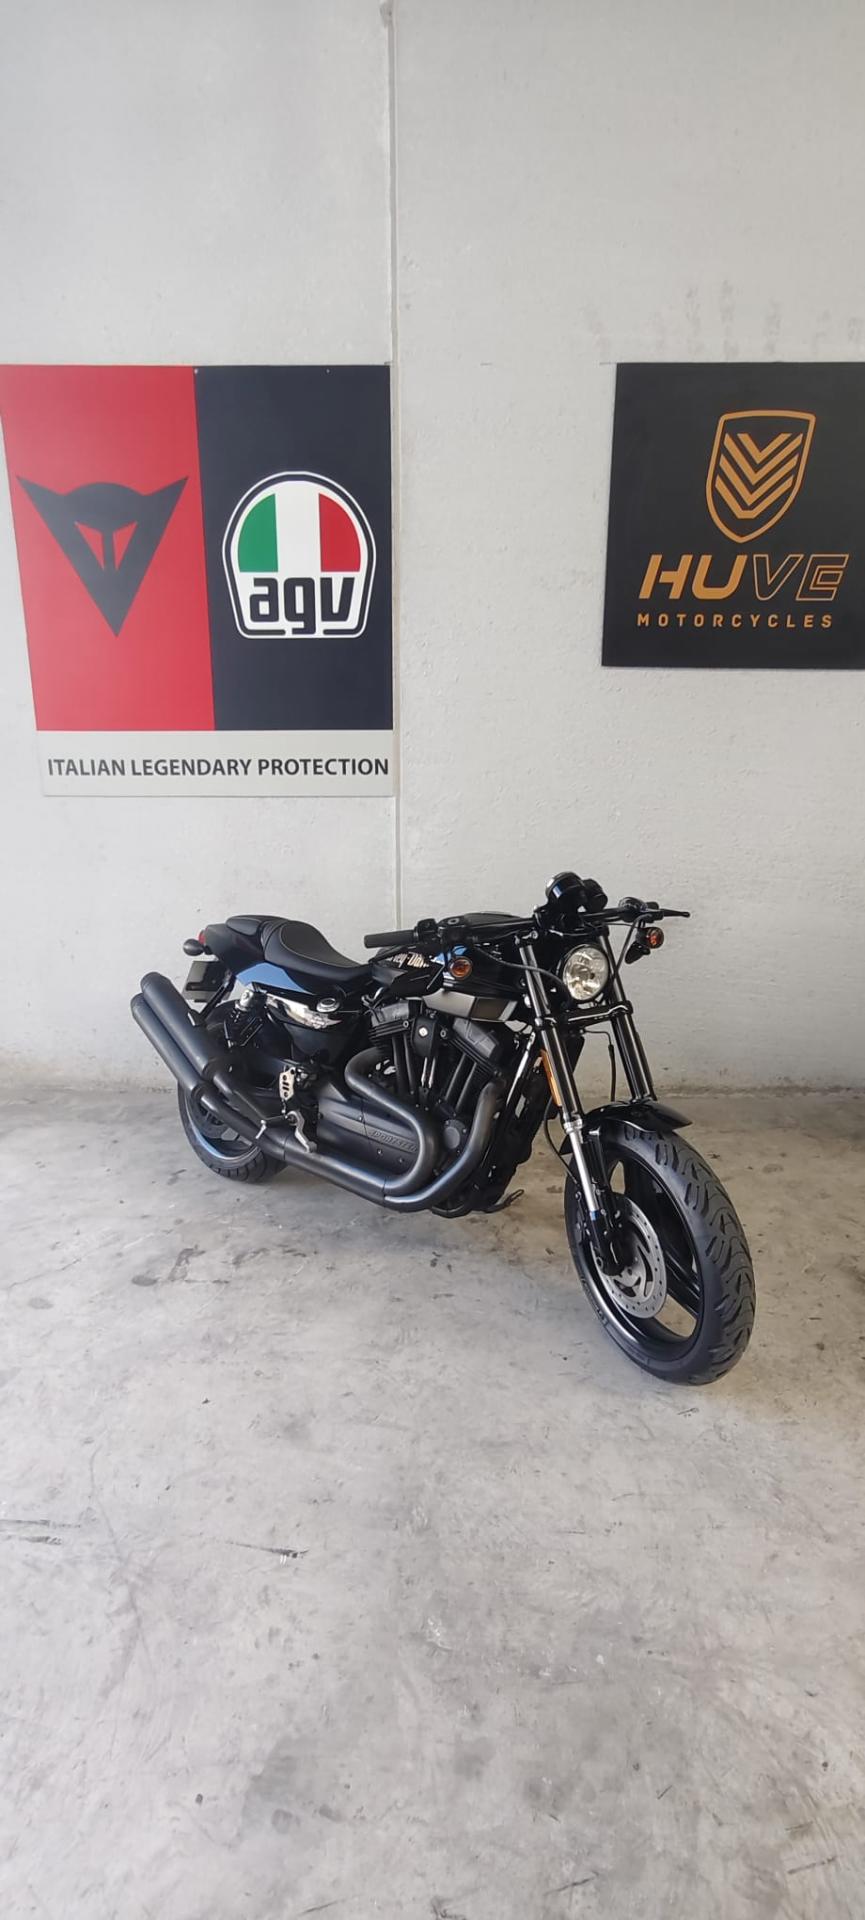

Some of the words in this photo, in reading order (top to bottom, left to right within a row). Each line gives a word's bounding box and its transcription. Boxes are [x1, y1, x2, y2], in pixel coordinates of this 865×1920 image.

[639, 553, 849, 601] HUVE
[249, 576, 356, 635] agv
[637, 613, 833, 628] MOTORCYCLES
[48, 759, 126, 777] ITALIAN
[131, 759, 252, 777] LEGENDARY
[257, 758, 389, 776] PROTECTION
